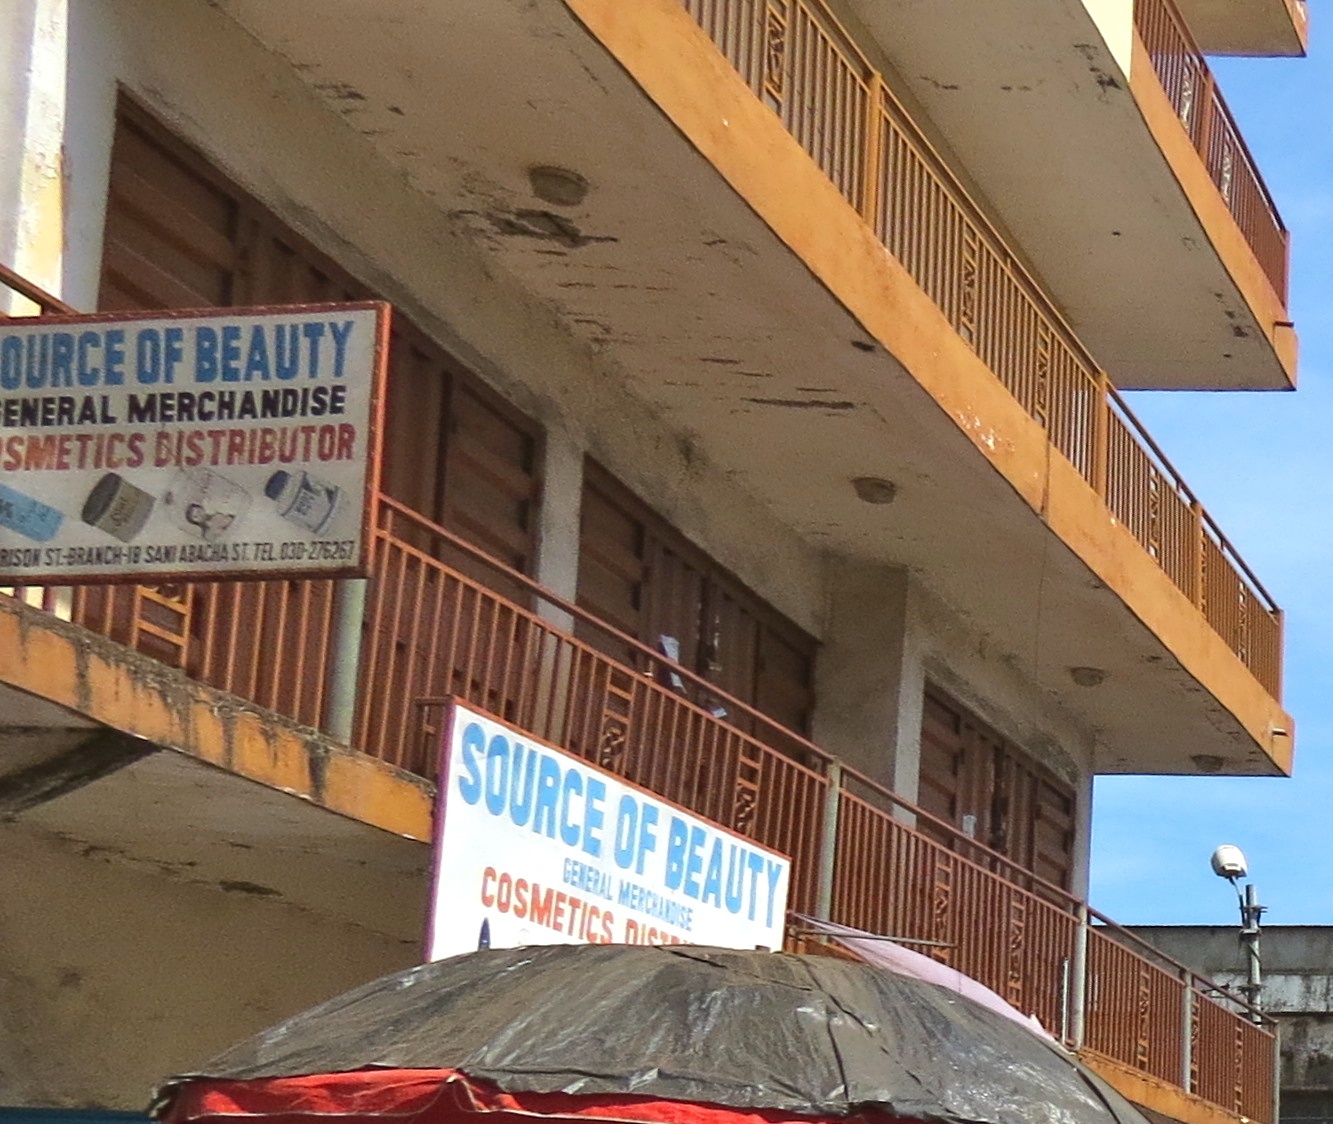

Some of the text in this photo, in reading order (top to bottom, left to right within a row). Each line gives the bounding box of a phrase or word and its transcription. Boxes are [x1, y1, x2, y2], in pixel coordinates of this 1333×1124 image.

[137, 327, 184, 383] OF
[195, 321, 354, 382] BEAUTY
[0, 386, 347, 427] ENERAL MERCHANDISE
[0, 423, 356, 471] SMETICS DISTRIBUTOR
[179, 544, 229, 562] ABACHA
[459, 722, 783, 929] SOURCE OF BEAUTY
[481, 866, 614, 944] COSMETICS
[563, 857, 693, 932] GENERAL MERCHANDISE
